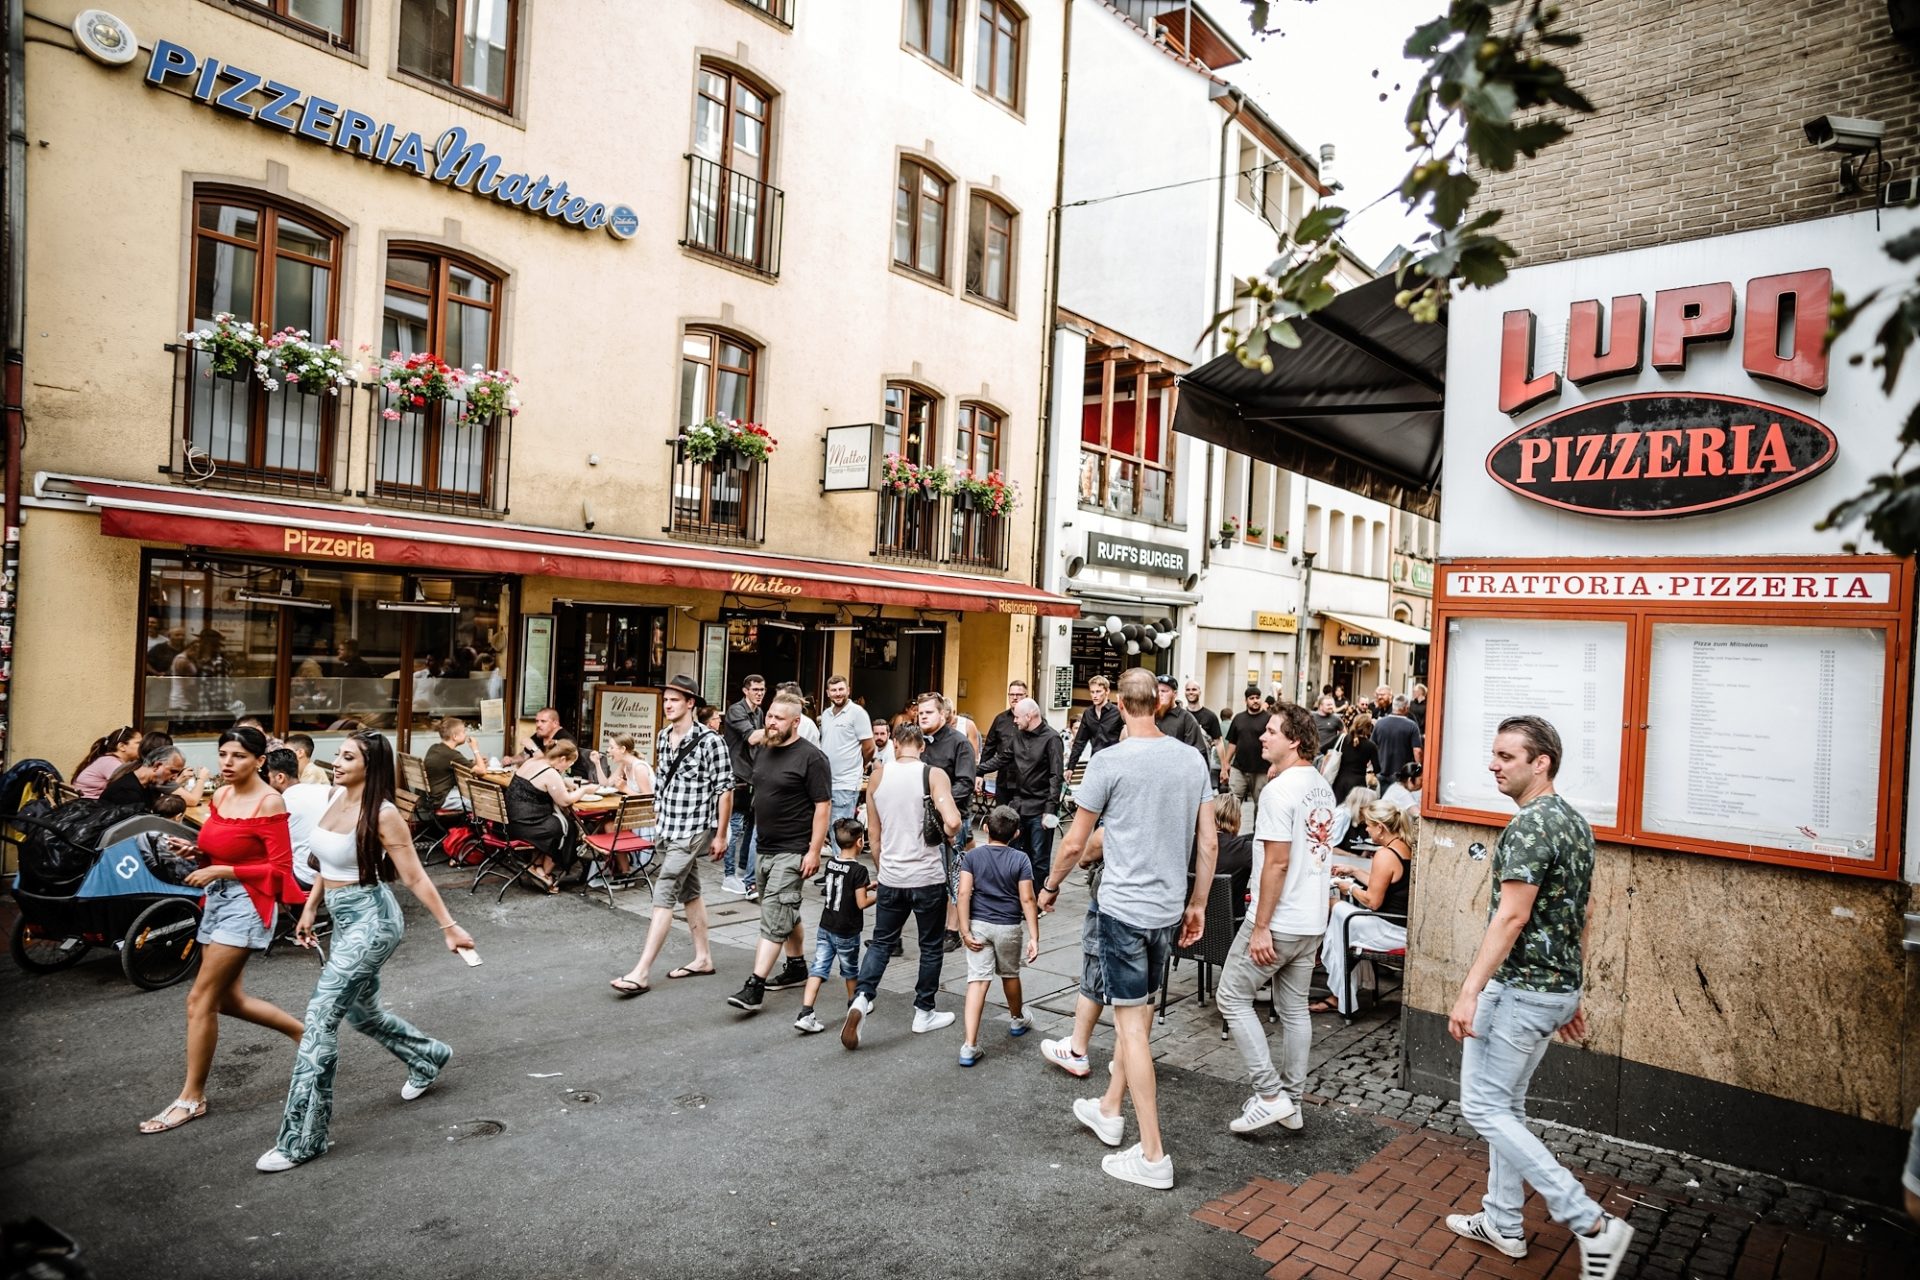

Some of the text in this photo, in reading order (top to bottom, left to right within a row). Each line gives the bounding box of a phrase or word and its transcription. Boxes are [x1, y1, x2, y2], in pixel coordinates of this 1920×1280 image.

[145, 38, 608, 230] PIZZERIA Matteo
[1498, 267, 1834, 416] LUPO
[829, 444, 867, 467] Matteo
[1516, 422, 1797, 484] PIZZERIA
[284, 528, 374, 560] Pizzeria
[1097, 541, 1184, 570] RUFF'S BURGER
[731, 572, 803, 596] Matteo
[1457, 574, 1873, 599] TRATTORIA PIZZERIA
[998, 599, 1038, 615] Ristorante
[1058, 624, 1068, 636] 19
[1259, 615, 1296, 628] GELDAUTOMAT
[1730, 641, 1769, 649] Mitnehmen
[611, 696, 649, 712] Matteo
[825, 872, 845, 911] 11
